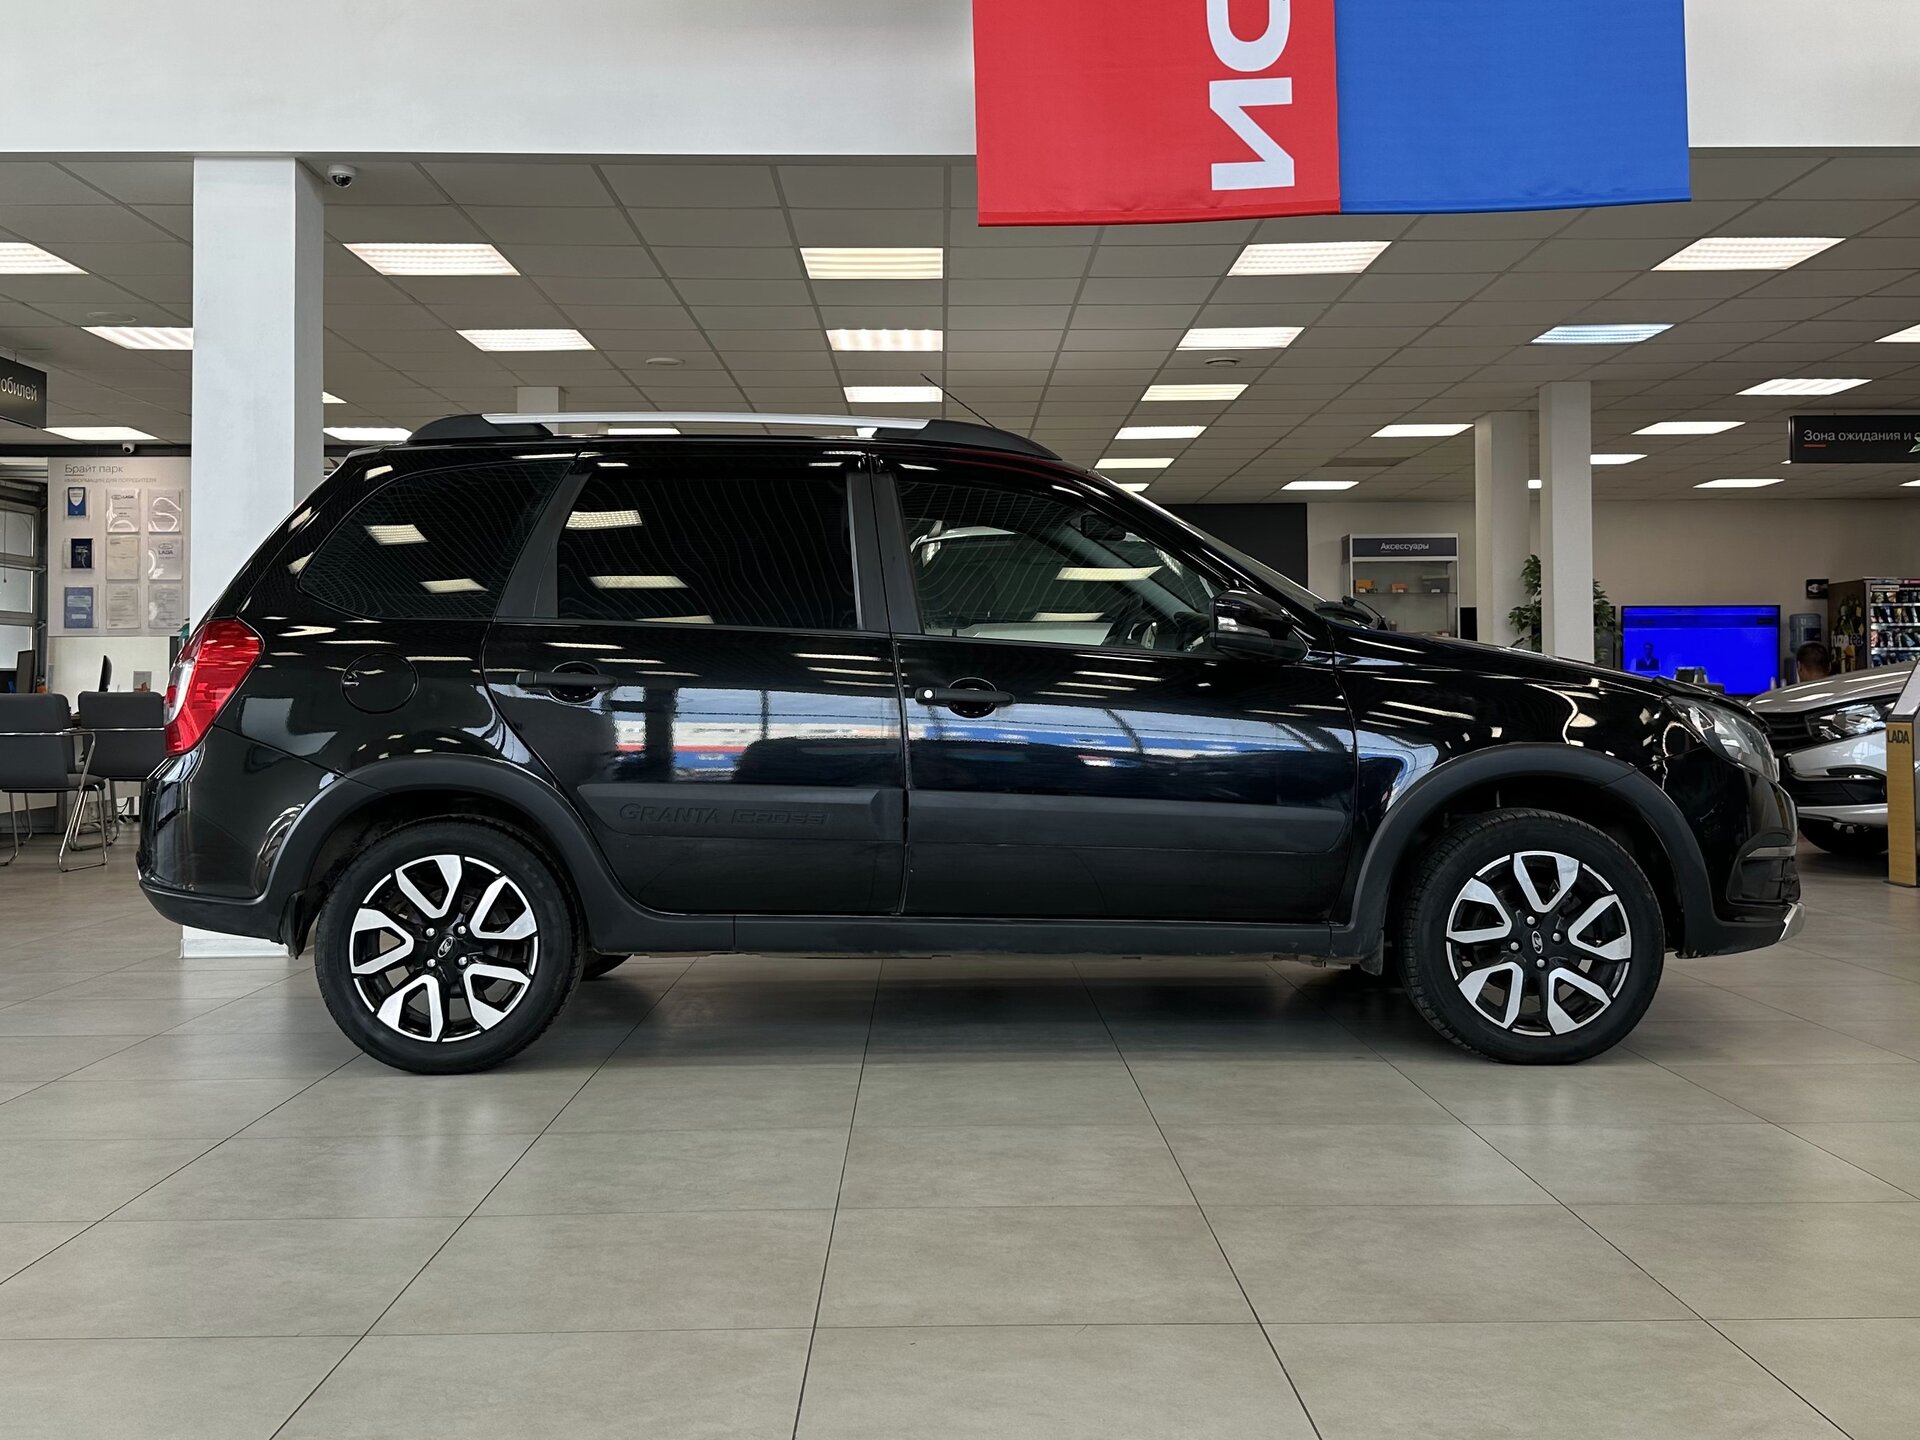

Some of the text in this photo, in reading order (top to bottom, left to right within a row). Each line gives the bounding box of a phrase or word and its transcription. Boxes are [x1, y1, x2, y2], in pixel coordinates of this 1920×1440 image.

[1803, 429, 1836, 441] Зона
[1838, 432, 1901, 442] ожидания
[1903, 432, 1912, 441] и
[65, 463, 124, 475] Брайт парк
[1380, 542, 1430, 551] Аксессуары
[1887, 729, 1910, 744] LADA
[619, 803, 719, 824] GRANTA
